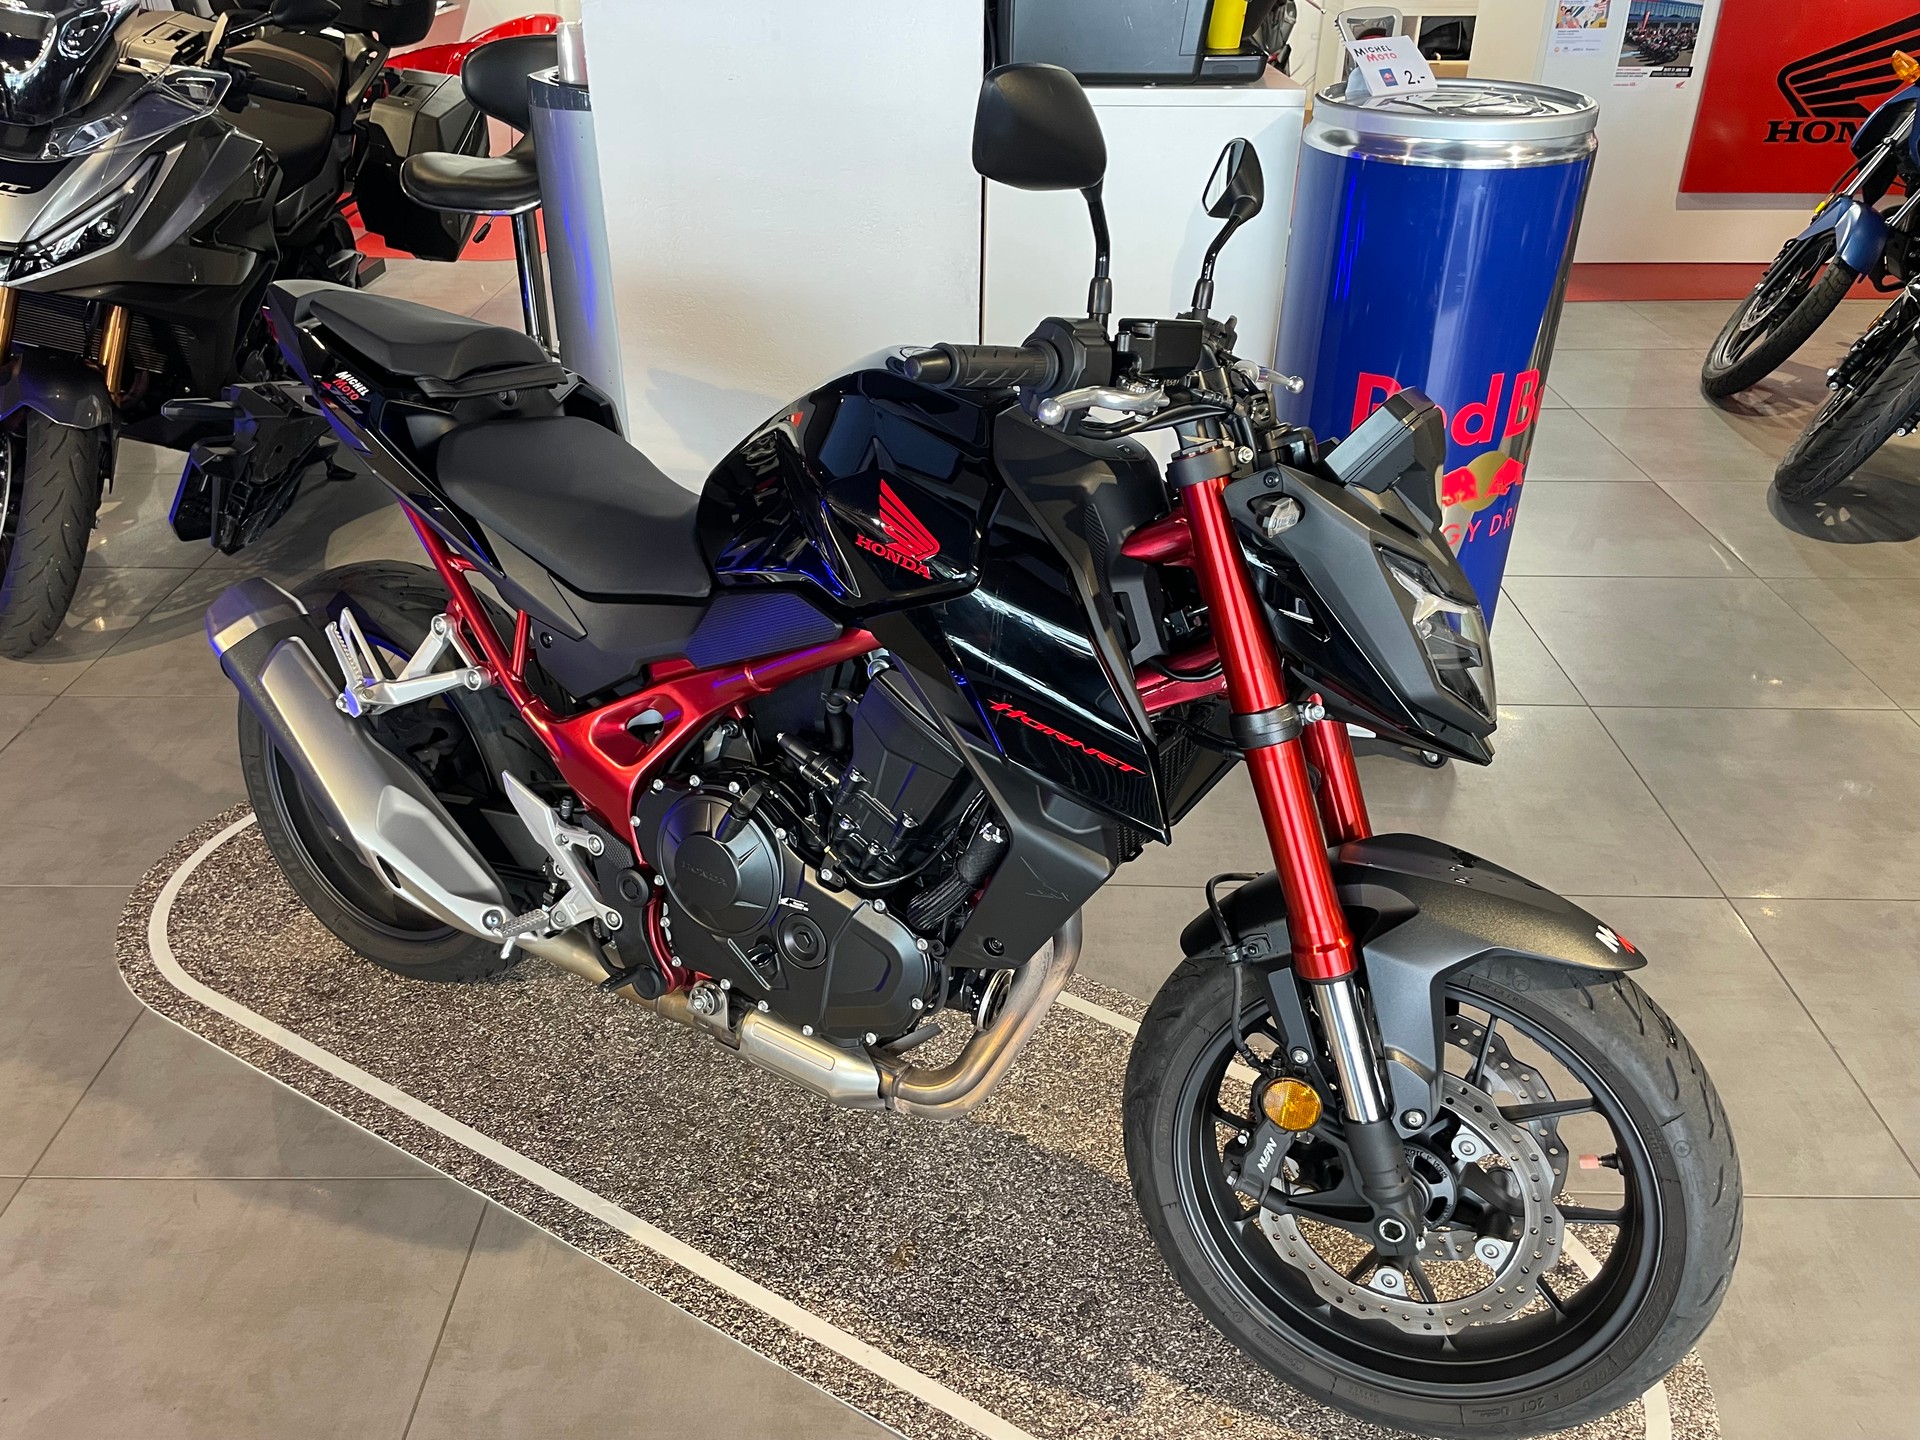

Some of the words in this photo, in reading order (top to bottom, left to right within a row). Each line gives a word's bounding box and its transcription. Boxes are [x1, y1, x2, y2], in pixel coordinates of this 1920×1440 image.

[1353, 45, 1393, 58] MICHEL
[1365, 52, 1398, 63] MOTO
[332, 379, 360, 401] MOTO
[335, 371, 370, 396] MICHEL
[1350, 370, 1505, 447] Rd
[1504, 368, 1545, 440] B
[855, 533, 933, 581] HONDA
[986, 699, 1147, 775] HORNET
